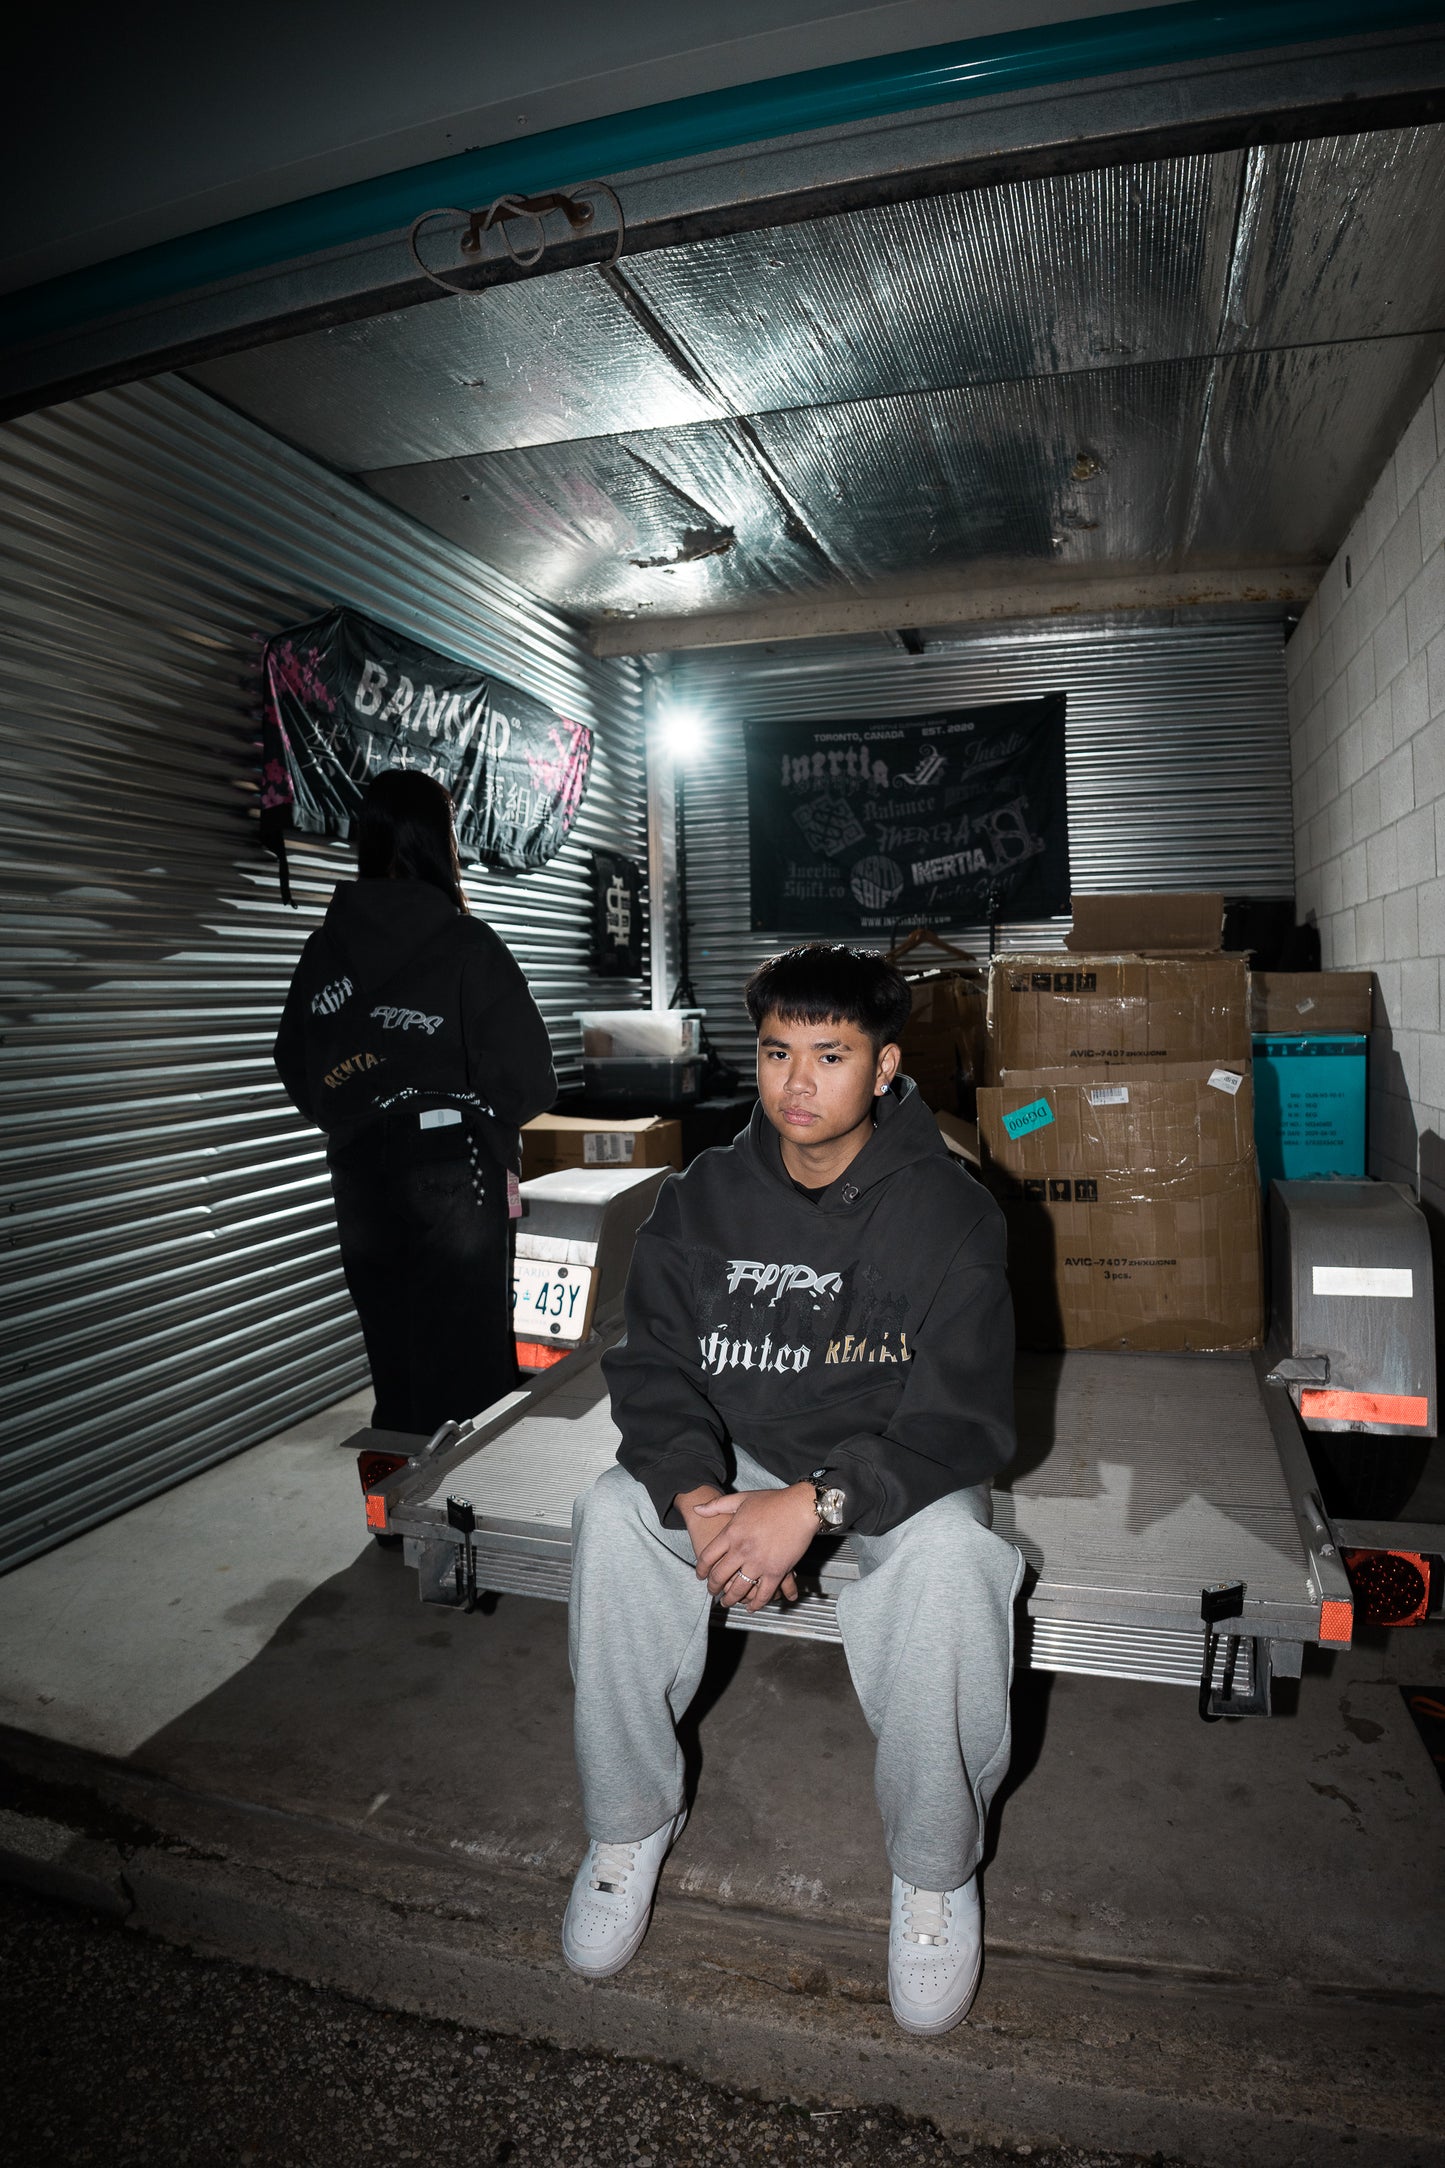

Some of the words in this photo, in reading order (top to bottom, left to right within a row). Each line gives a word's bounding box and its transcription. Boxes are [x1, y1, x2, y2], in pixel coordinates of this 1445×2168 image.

[813, 732, 863, 742] TORONTO,
[863, 730, 905, 741] CANADA
[921, 726, 946, 736] EST.
[947, 722, 975, 734] 2020
[910, 847, 988, 886] INERTIA
[323, 1052, 387, 1089] RENTA
[1103, 1270, 1111, 1279] 3
[1112, 1272, 1132, 1280] pcs.
[535, 1282, 581, 1318] 43Y
